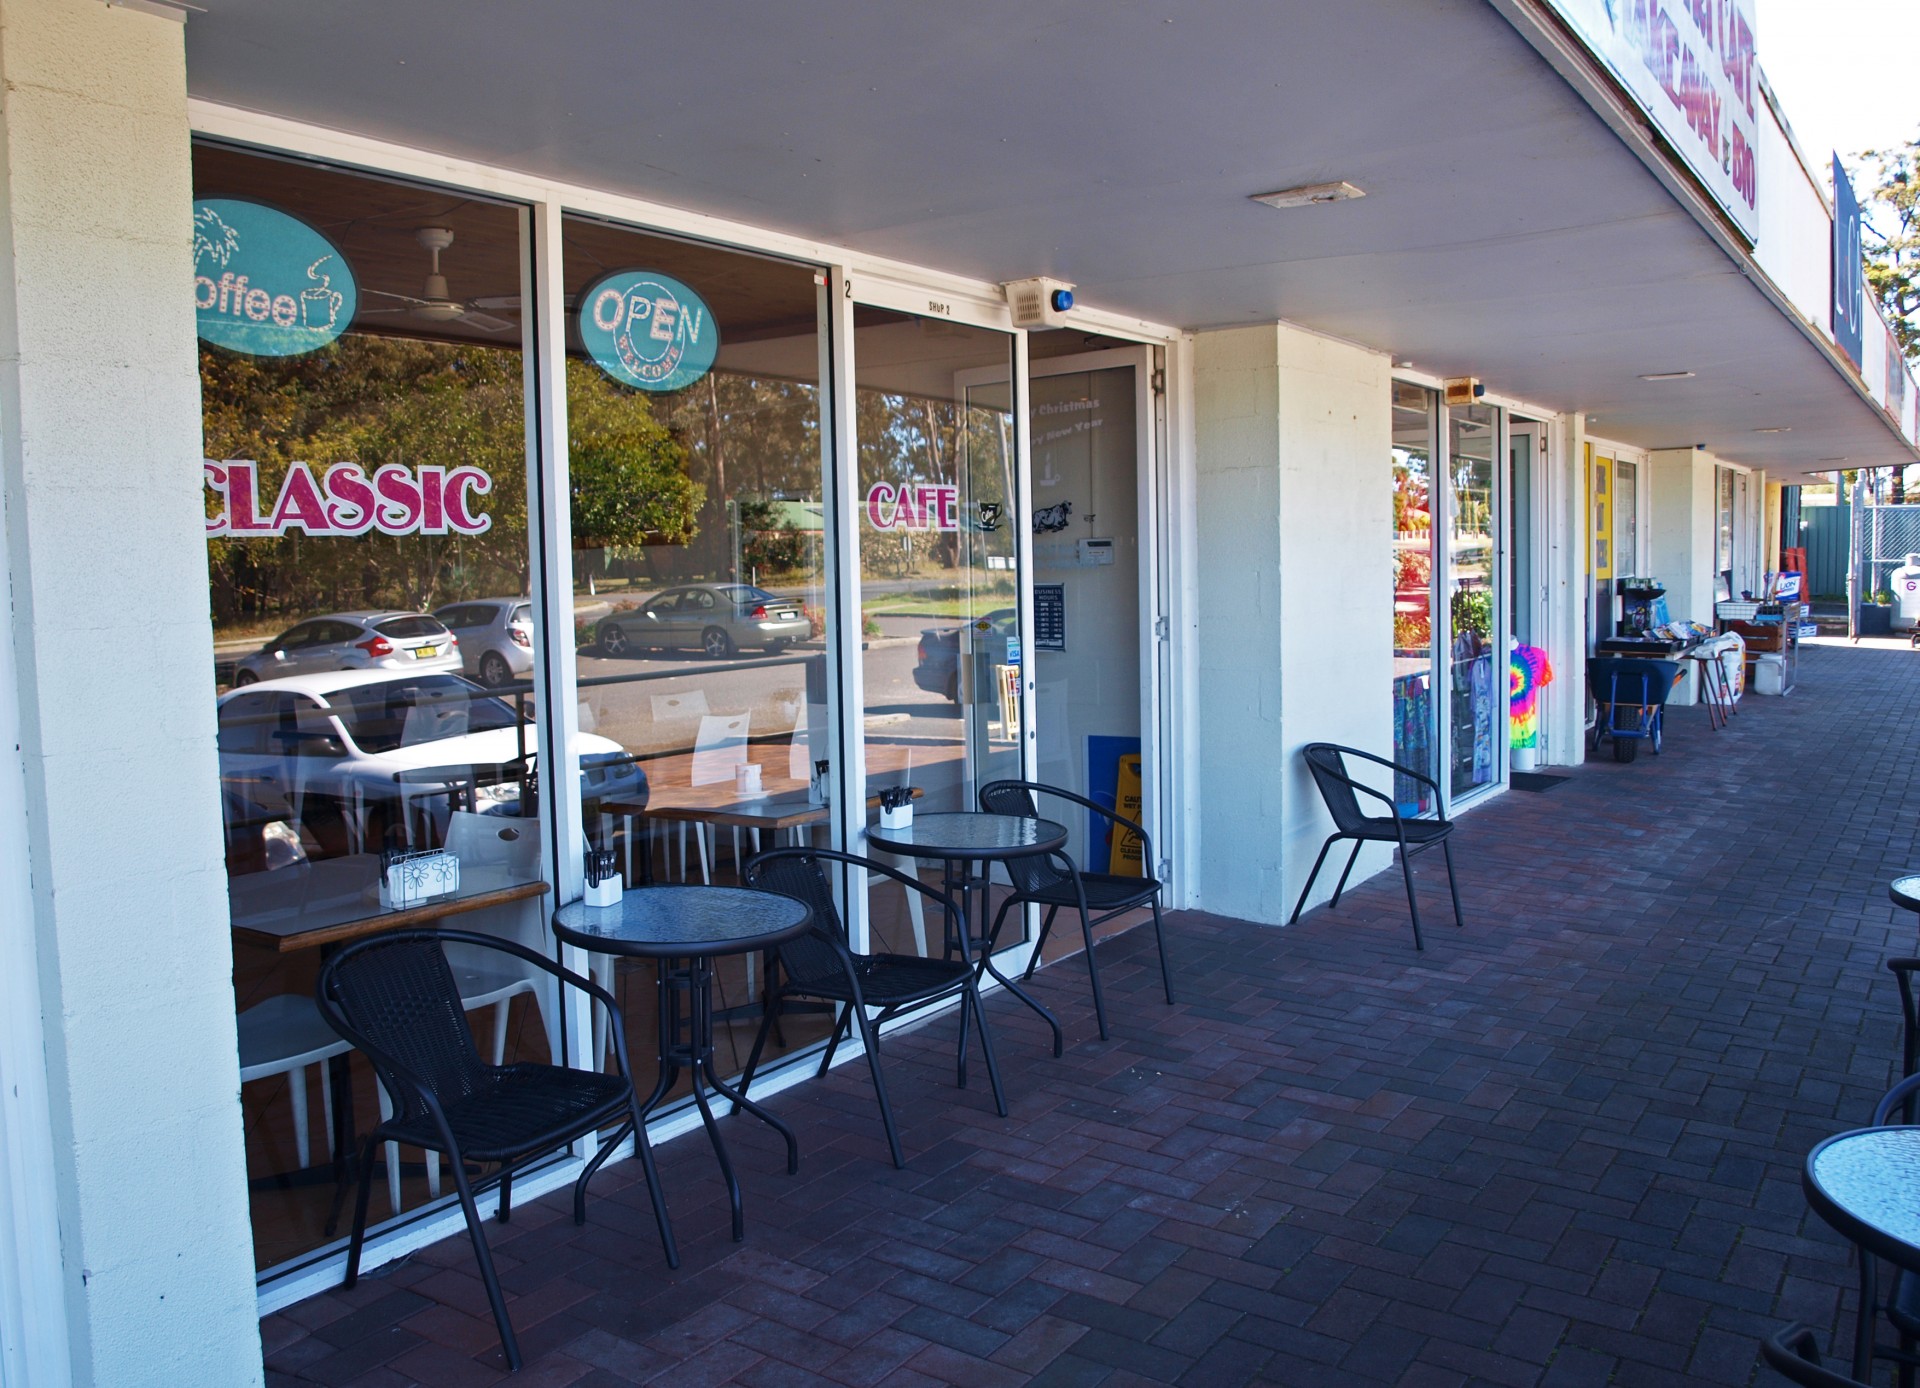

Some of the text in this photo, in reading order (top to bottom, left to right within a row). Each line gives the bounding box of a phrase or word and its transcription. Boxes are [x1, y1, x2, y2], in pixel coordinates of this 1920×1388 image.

[845, 280, 851, 298] 2
[593, 289, 702, 344] OPEN
[946, 305, 950, 315] 2
[618, 335, 679, 378] WELCOME
[1039, 400, 1100, 415] Christmas
[1075, 419, 1103, 431] Year
[867, 482, 957, 531] CAFE
